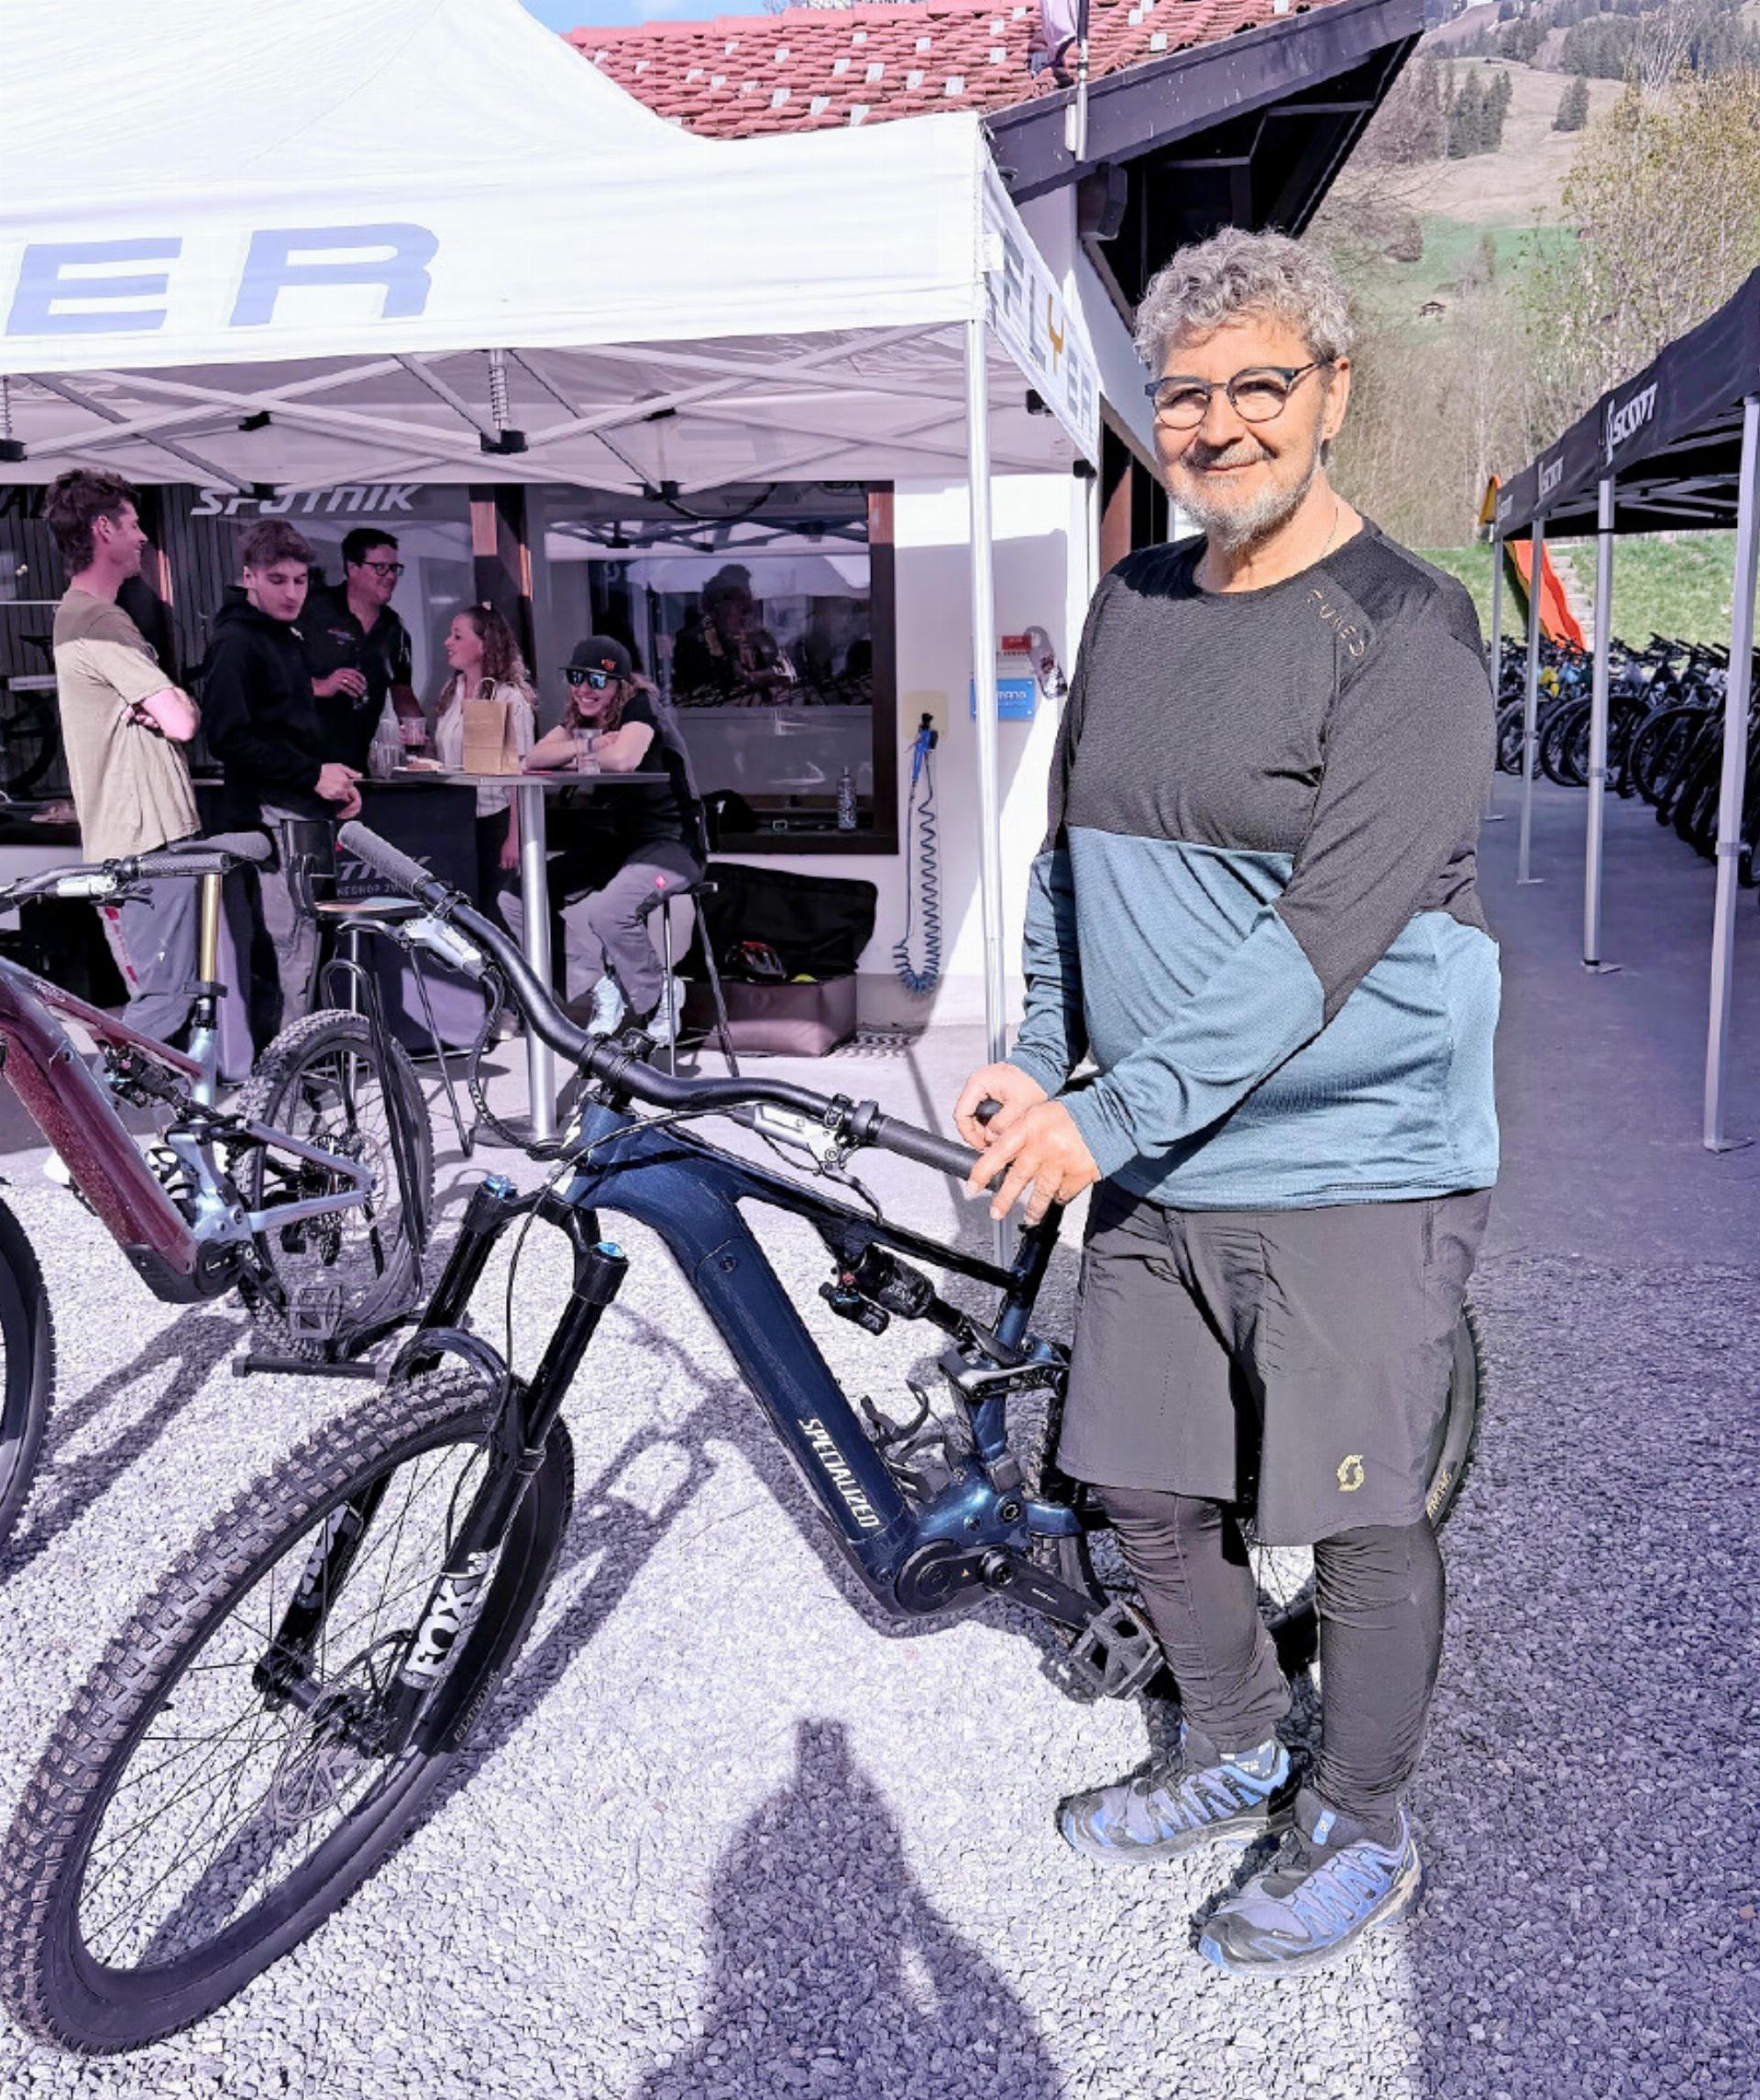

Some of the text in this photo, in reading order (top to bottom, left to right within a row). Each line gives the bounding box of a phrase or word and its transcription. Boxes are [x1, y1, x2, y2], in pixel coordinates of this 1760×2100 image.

[5, 222, 440, 336] ER
[1004, 228, 1093, 442] FLYER
[798, 1418, 881, 1528] SPECIALIZED
[405, 1578, 478, 1677] FOX
